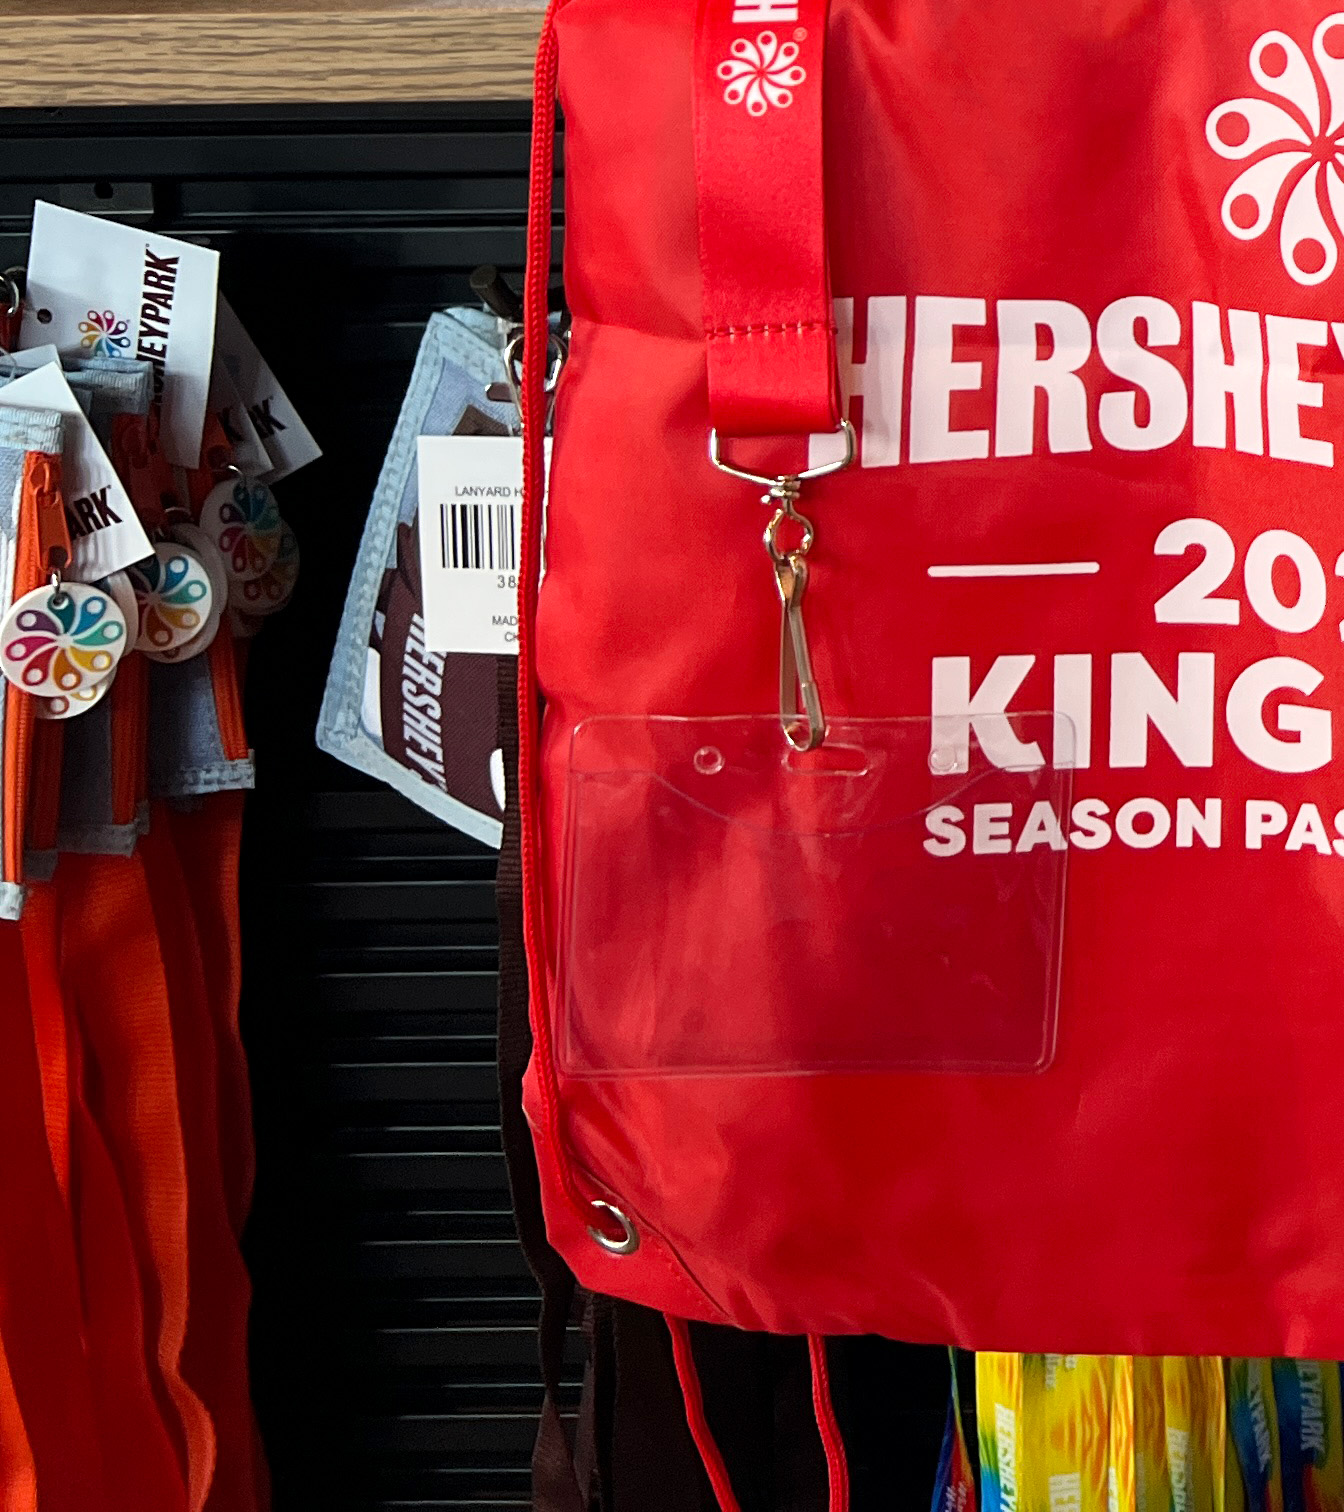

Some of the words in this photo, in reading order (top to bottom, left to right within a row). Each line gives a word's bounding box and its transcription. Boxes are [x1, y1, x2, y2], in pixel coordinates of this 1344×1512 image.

[454, 485, 511, 498] LANYARD
[929, 652, 1334, 777] KING
[922, 796, 1223, 859] SEASON
